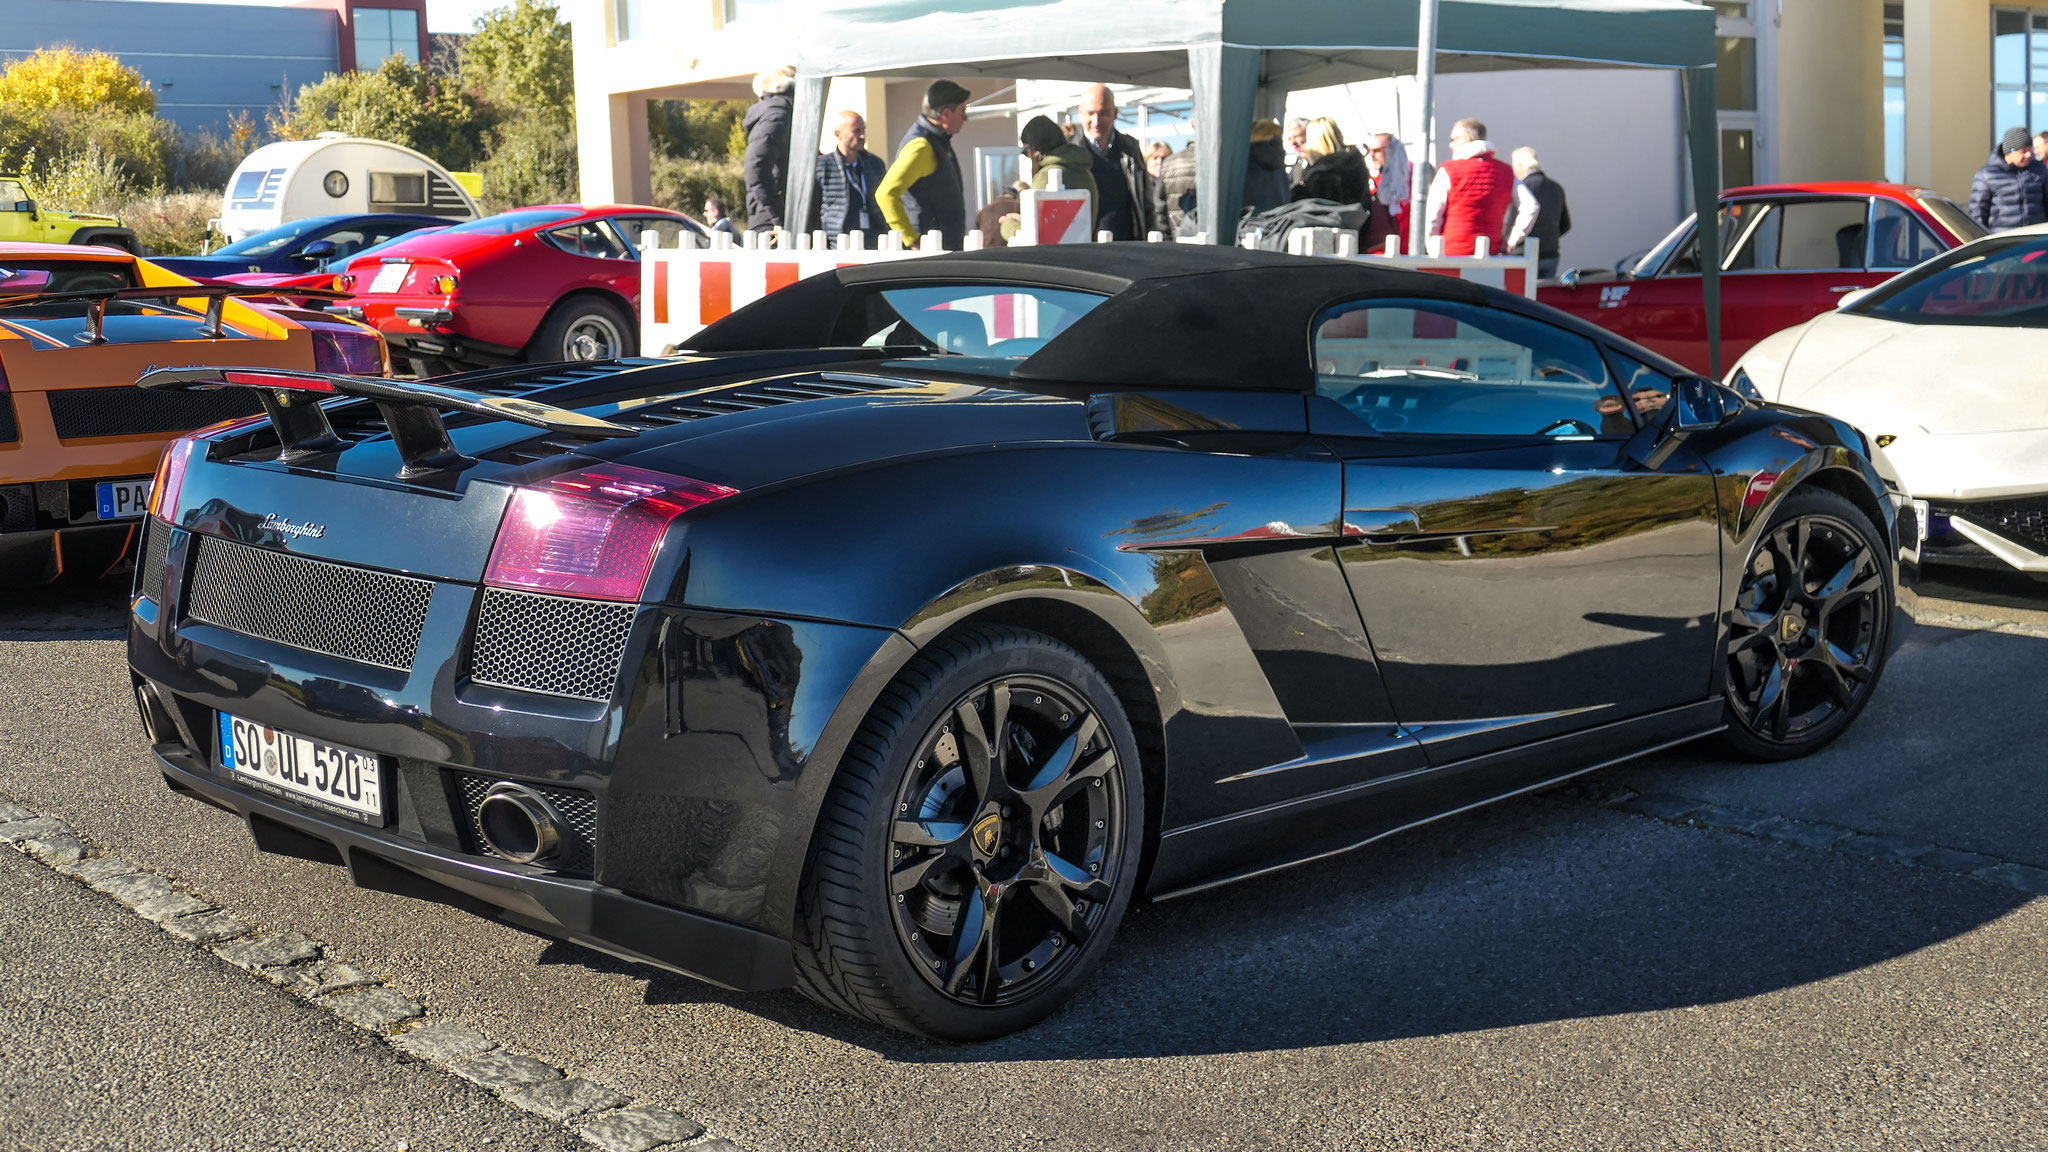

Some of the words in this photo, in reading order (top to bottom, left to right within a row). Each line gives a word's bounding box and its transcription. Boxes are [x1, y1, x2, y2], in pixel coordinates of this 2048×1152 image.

[116, 484, 151, 513] PA
[103, 504, 110, 513] D
[257, 512, 326, 539] Lamborghini
[225, 745, 231, 758] D
[234, 720, 261, 771] SO
[277, 733, 309, 786] UL
[313, 743, 361, 801] 520
[362, 756, 375, 772] 03
[365, 791, 377, 807] 11
